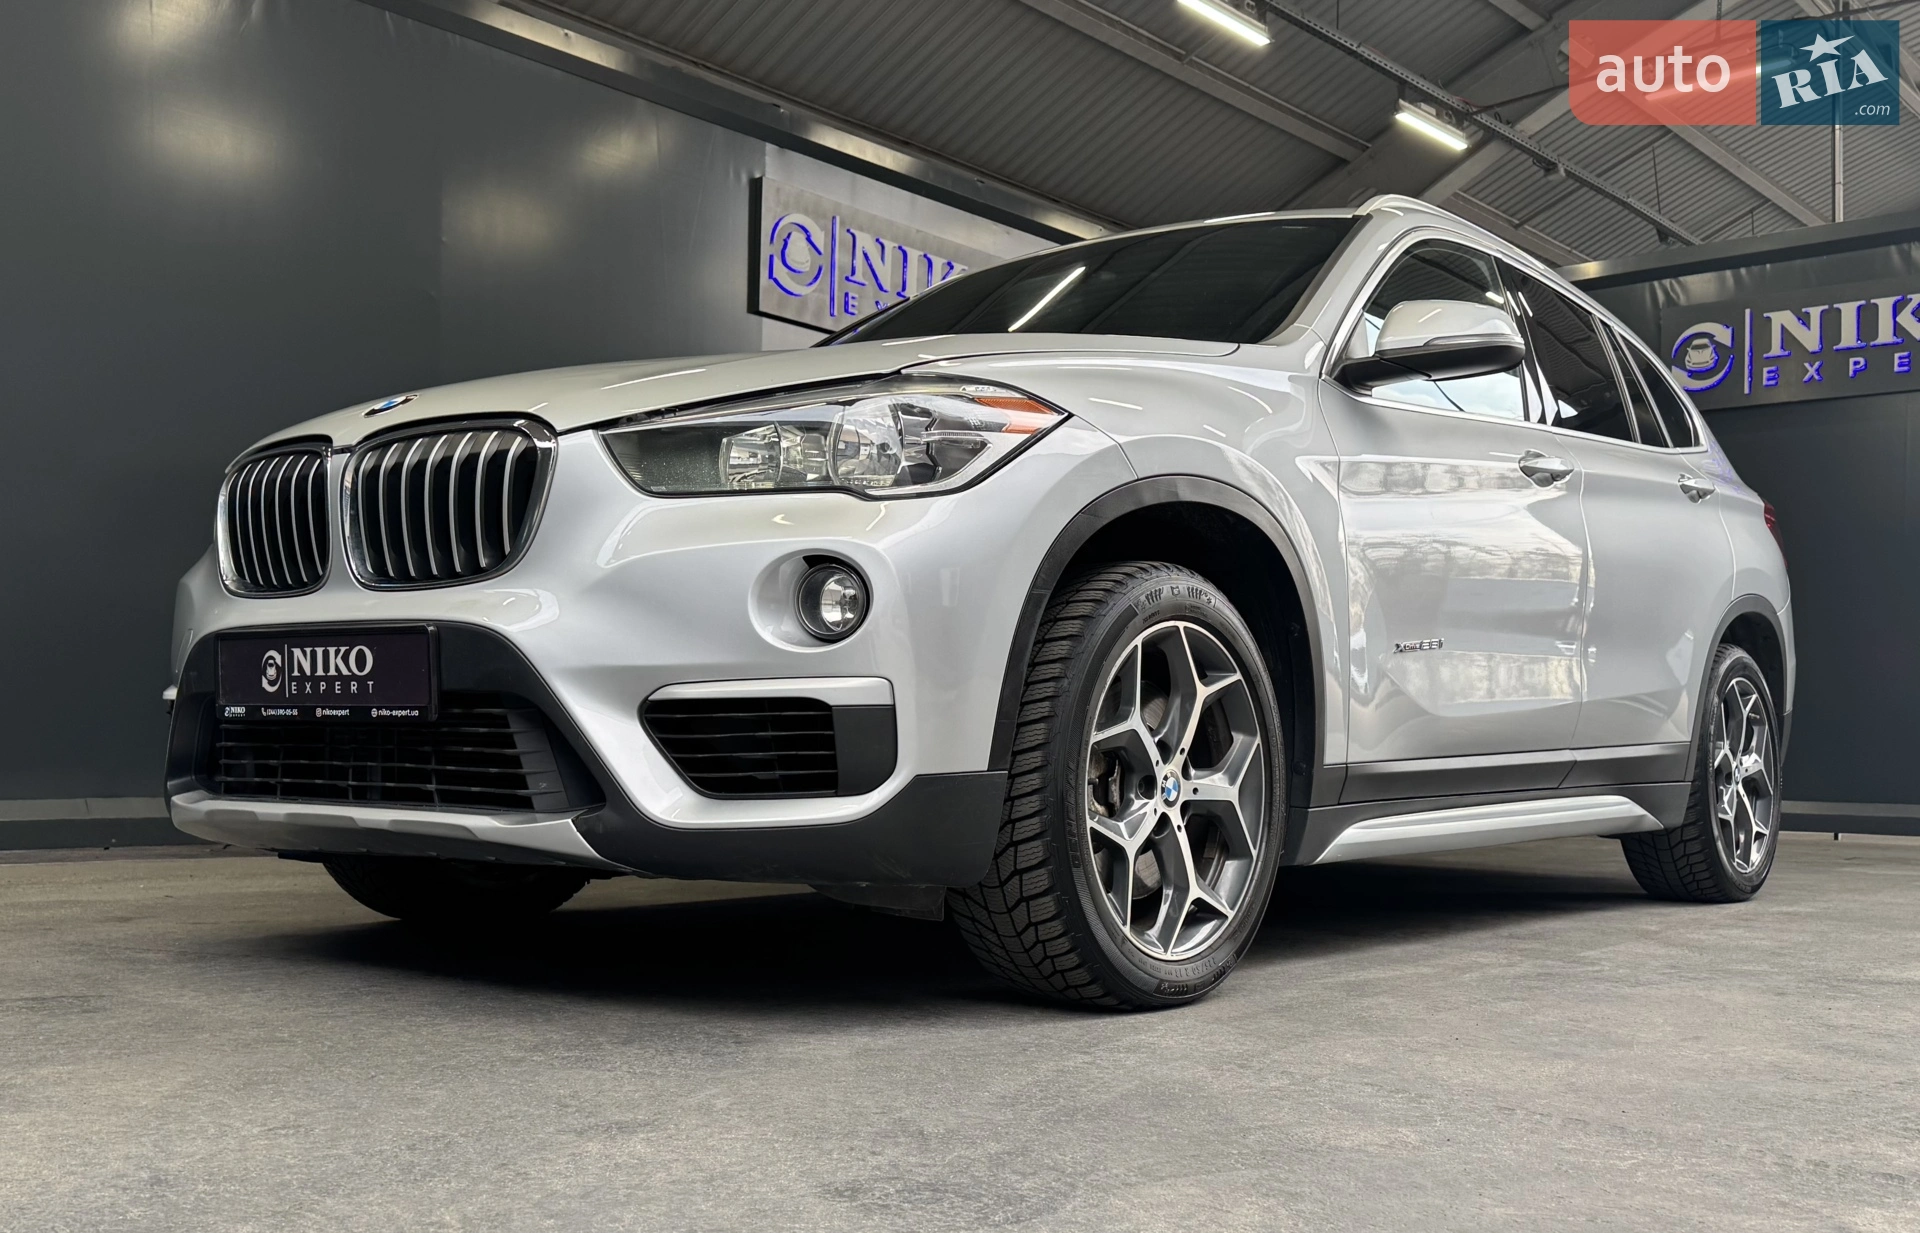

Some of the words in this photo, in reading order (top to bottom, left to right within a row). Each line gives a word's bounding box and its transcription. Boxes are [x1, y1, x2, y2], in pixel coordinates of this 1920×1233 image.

[1762, 351, 1912, 387] EXPE
[291, 645, 374, 676] NIKO
[291, 681, 374, 694] EXPERT
[230, 706, 246, 714] NIKO
